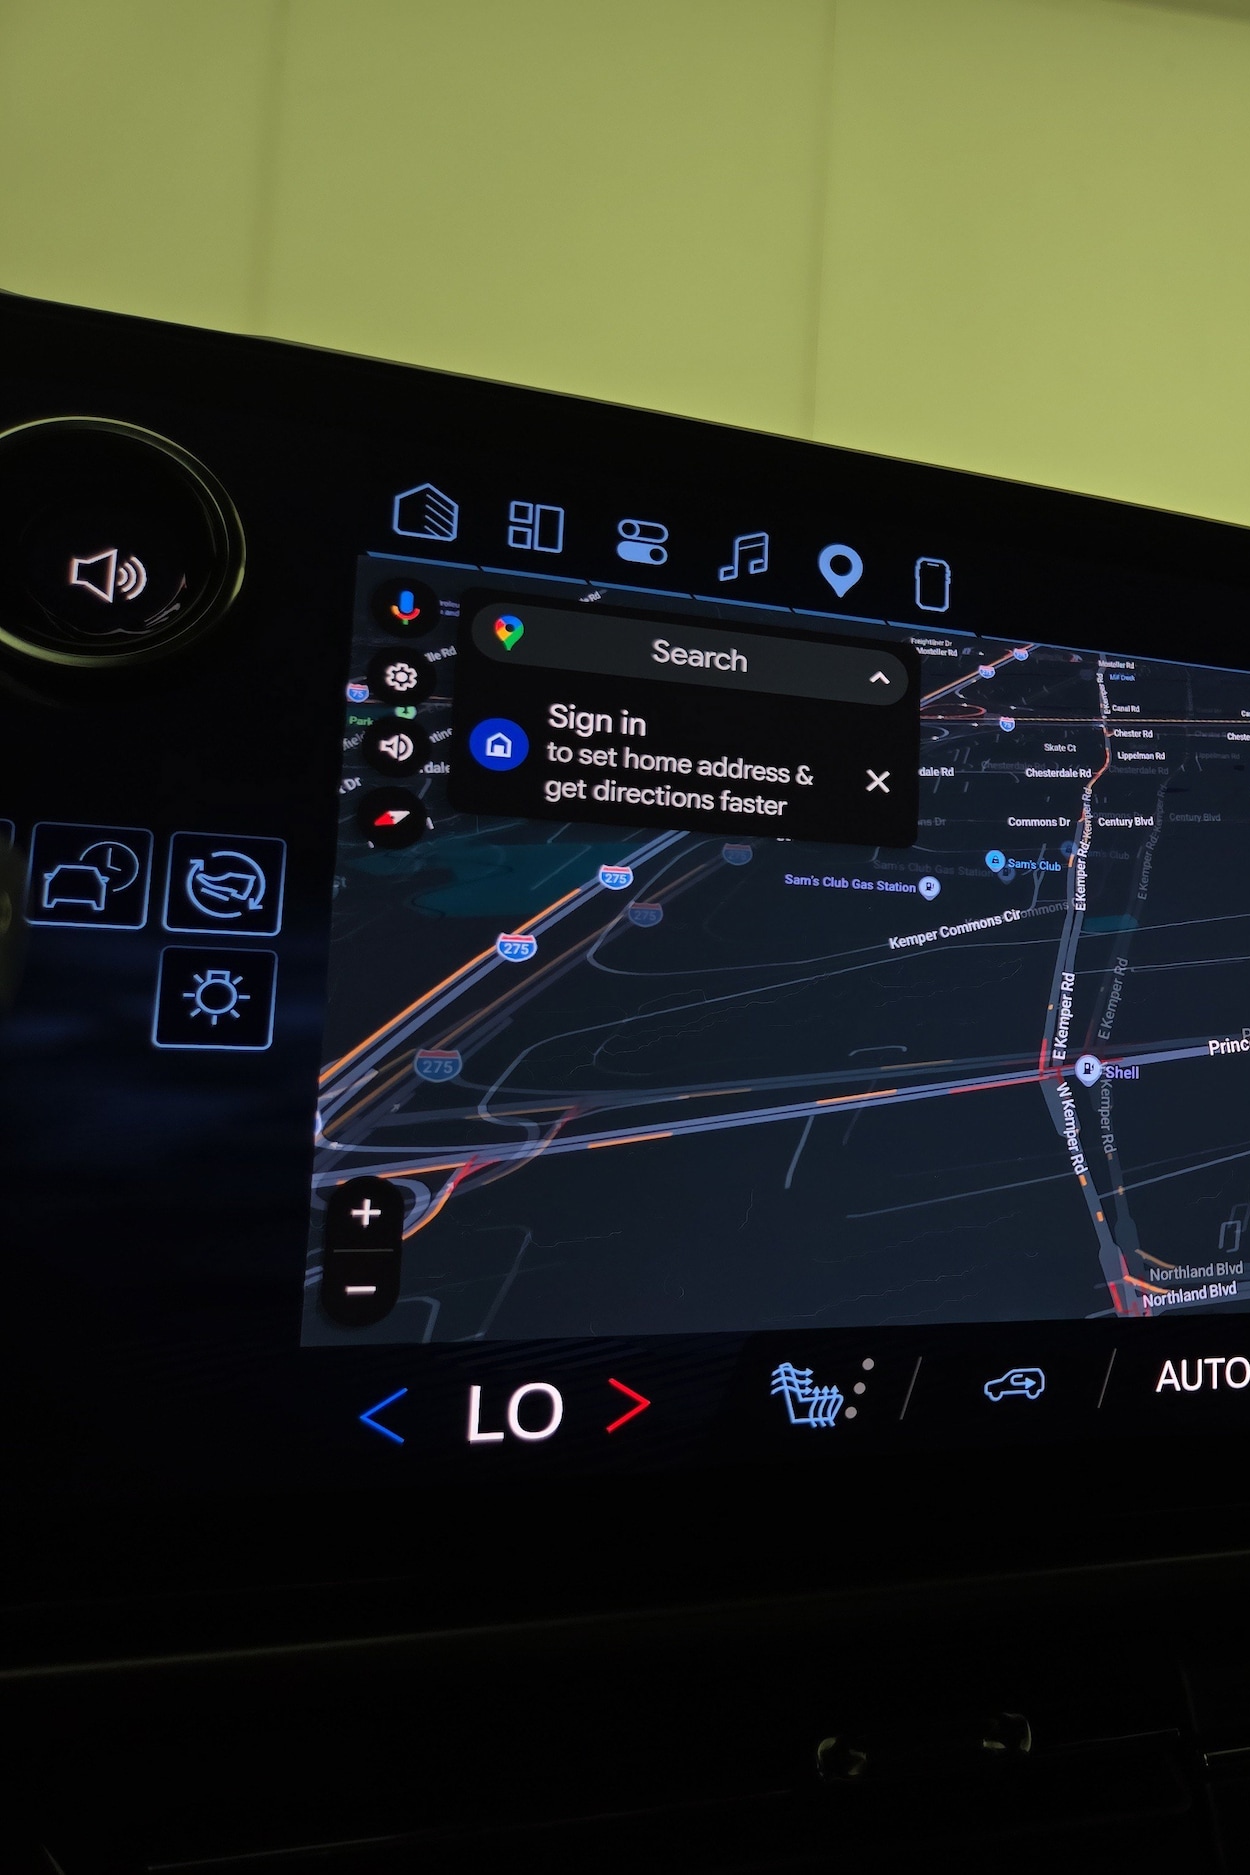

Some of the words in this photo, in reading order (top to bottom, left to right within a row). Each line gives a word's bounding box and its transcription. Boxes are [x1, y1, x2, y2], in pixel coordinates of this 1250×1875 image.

[652, 638, 749, 673] Search
[948, 648, 958, 657] Rd
[1126, 661, 1135, 669] Rd
[1112, 704, 1130, 712] Canal
[349, 715, 374, 727] Park
[548, 702, 613, 738] Sign
[620, 708, 647, 737] in
[1114, 728, 1141, 738] Chester
[1143, 729, 1153, 738] Rd
[1044, 743, 1066, 752] Skate
[1067, 744, 1077, 752] Ct
[546, 741, 572, 764] to
[578, 746, 618, 768] set
[623, 746, 693, 775] home
[696, 756, 791, 784] address
[795, 764, 814, 785] &
[1117, 751, 1154, 761] Lippelman
[1155, 752, 1166, 760] Rd
[941, 767, 955, 777] Rd
[1025, 767, 1078, 778] Chesterdale
[1079, 768, 1092, 778] Rd
[343, 777, 362, 792] Dr
[544, 778, 588, 803] get
[593, 779, 714, 811] directions
[720, 789, 788, 816] faster
[1082, 786, 1092, 801] Rd
[1007, 817, 1057, 827] Commons
[1059, 817, 1071, 827] Dr
[1098, 817, 1134, 828] Century
[1134, 816, 1154, 826] Blvd
[1077, 840, 1091, 858] Rd
[1008, 858, 1037, 870] Sam's
[1039, 861, 1062, 871] Club
[605, 872, 627, 884] 275
[785, 874, 820, 887] Sam's
[822, 875, 849, 889] Club
[852, 878, 874, 890] Gas
[876, 879, 917, 894] Station
[1075, 859, 1088, 900] Kemper
[1075, 901, 1086, 911] E
[889, 929, 938, 949] Kemper
[939, 913, 1002, 938] Commons
[1003, 908, 1021, 922] Cir
[504, 942, 529, 955] 275
[1061, 971, 1076, 992] Rd
[1054, 993, 1073, 1049] Kemper
[1052, 1050, 1066, 1060] E
[422, 1060, 454, 1074] 275
[1105, 1065, 1139, 1080] Shell
[1056, 1081, 1073, 1097] W
[1062, 1098, 1079, 1154] Kemper
[1070, 1153, 1088, 1175] Rd
[1150, 1262, 1214, 1282] Northland
[1216, 1260, 1244, 1276] Blvd
[1142, 1287, 1208, 1308] Northland
[1209, 1280, 1238, 1298] Blvd
[467, 1381, 565, 1445] LO
